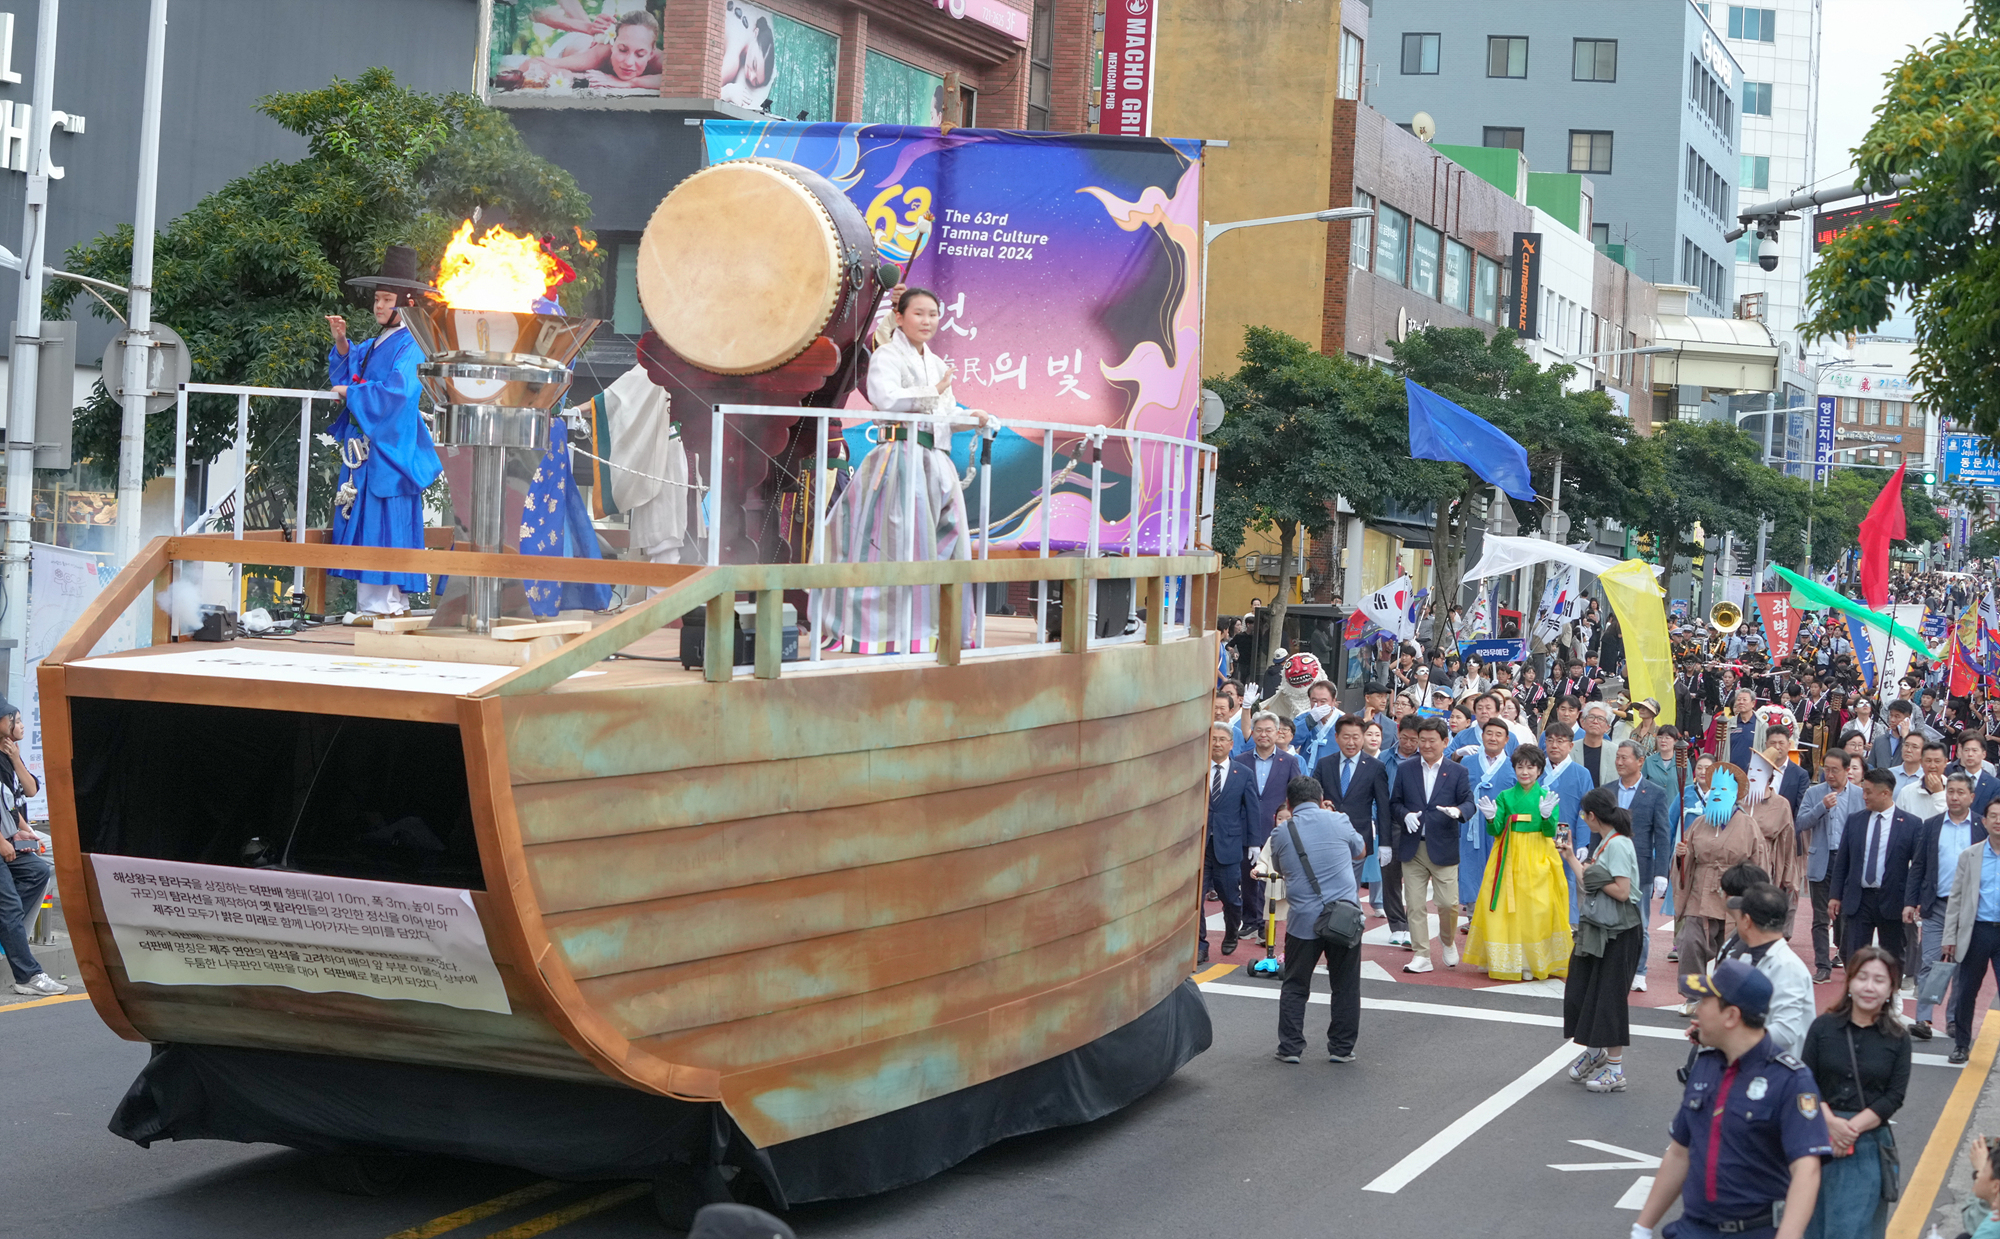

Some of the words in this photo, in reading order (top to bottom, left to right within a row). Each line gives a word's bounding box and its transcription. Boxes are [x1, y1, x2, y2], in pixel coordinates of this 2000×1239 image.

[1005, 10, 1016, 32] 3F
[1106, 52, 1118, 89] MEXICAN
[1122, 18, 1147, 91] MACHO
[1105, 90, 1116, 110] PUB
[1120, 98, 1142, 137] GRI
[941, 225, 989, 242] Tamna
[993, 229, 1048, 245] Culture
[944, 209, 971, 223] The
[974, 211, 1009, 226] 63rd
[938, 242, 994, 258] Festival
[998, 246, 1033, 261] 2024
[1518, 252, 1530, 331] CLIMBERHOLIC
[1047, 348, 1091, 400] 빛
[1960, 448, 1974, 456] Jeju
[1960, 457, 2000, 469] 동문시
[1960, 467, 1987, 476] Dongmun
[113, 872, 157, 885] 해상왕국
[158, 875, 201, 890] 탐라국을
[204, 880, 247, 895] 상징하는
[249, 884, 283, 898] 덕판배
[370, 894, 385, 907] 폭
[411, 900, 434, 913] 높이
[437, 904, 459, 917] 5m
[130, 888, 167, 901] 규모)의
[169, 892, 214, 906] 탐라선을
[215, 896, 258, 911] 제작하여
[273, 902, 329, 917] 탐라인들의
[331, 906, 364, 921] 강인한
[366, 911, 399, 925] 정신을
[152, 904, 186, 917] 제주인
[187, 908, 220, 922] 모두가
[221, 911, 243, 924] 밝은
[245, 913, 279, 927] 미래로
[280, 916, 302, 929] 함께
[305, 919, 360, 935] 나아가자는
[361, 925, 395, 938] 의미를
[397, 928, 434, 943] 담았다.
[139, 940, 173, 952] 덕판배
[174, 942, 207, 954] 명칭은
[208, 944, 231, 956] 제주
[232, 945, 266, 958] 연안의
[266, 948, 300, 961] 암석을
[302, 952, 347, 966] 고려하여
[347, 957, 370, 969] 배의
[371, 960, 383, 971] 앞
[385, 961, 408, 973] 부분
[443, 974, 478, 985] 상부에
[184, 957, 217, 969] 두툼한
[218, 958, 262, 971] 나무판인
[263, 961, 296, 974] 덕판을
[297, 965, 318, 978] 대어
[323, 966, 369, 981] 덕판배로
[369, 971, 403, 986] 불리게
[405, 976, 441, 991] 되었다.
